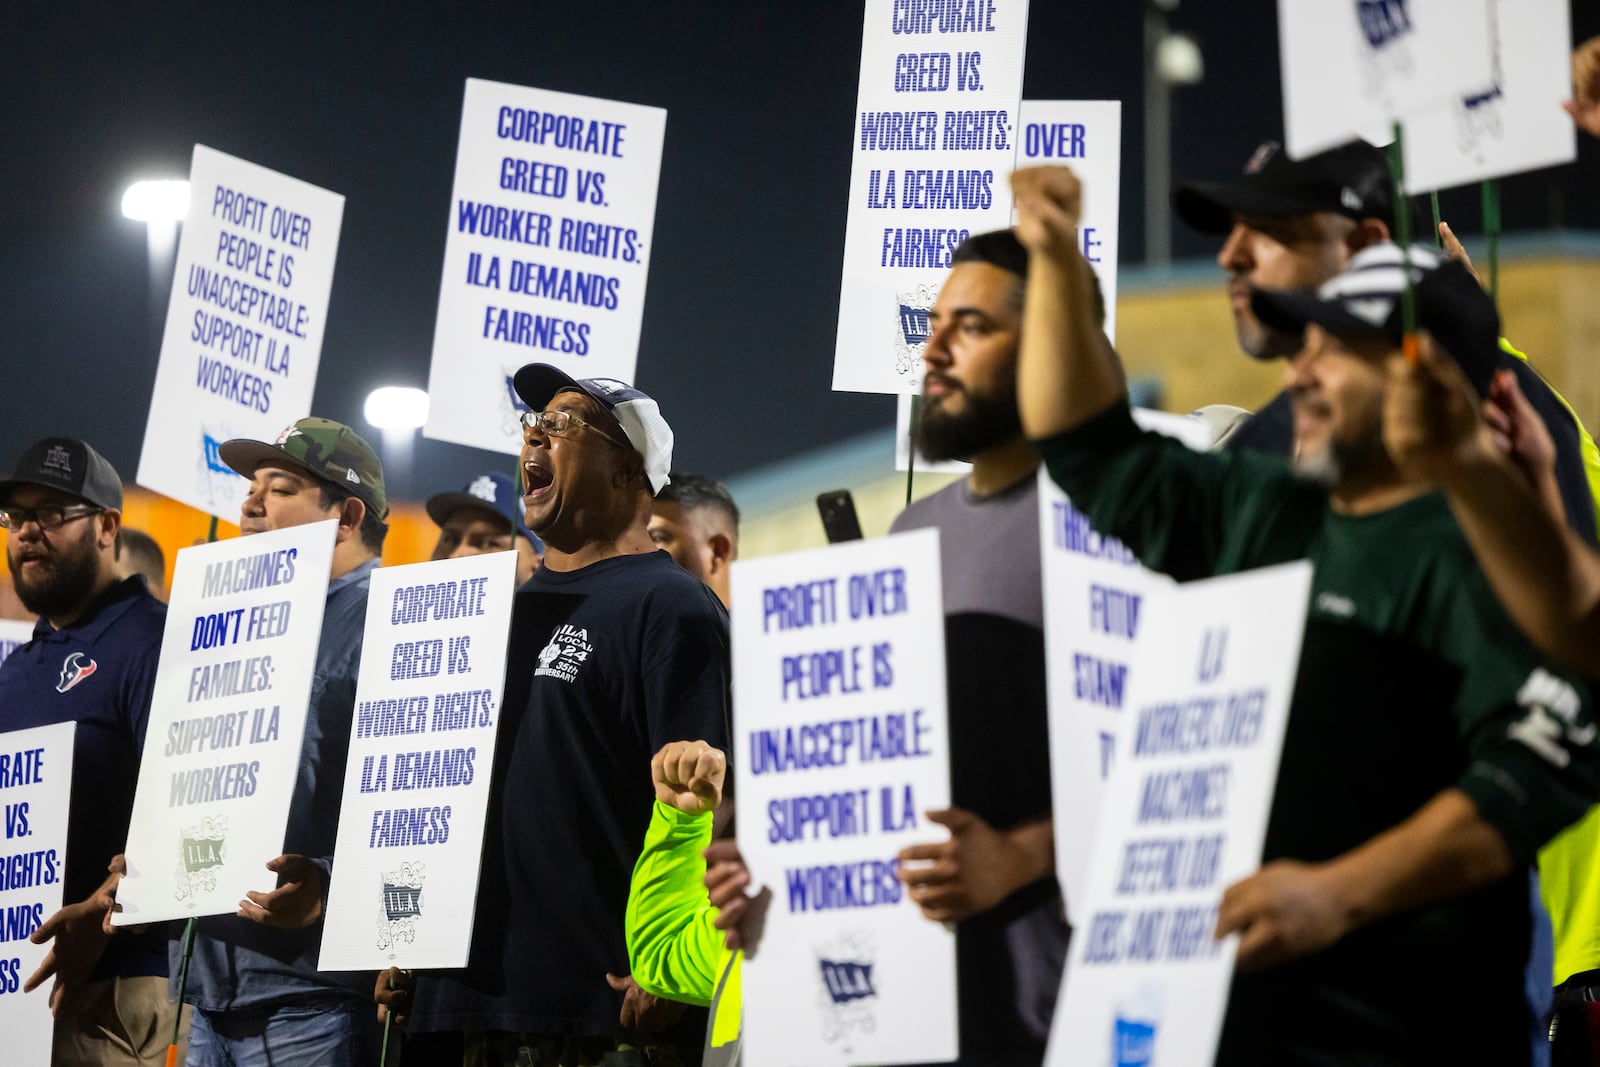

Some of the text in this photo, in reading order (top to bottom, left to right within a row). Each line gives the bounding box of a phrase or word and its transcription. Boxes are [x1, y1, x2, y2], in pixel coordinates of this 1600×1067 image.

[892, 0, 996, 35] CORPORATE
[895, 51, 984, 92] GREED VS.
[497, 106, 626, 158] CORPORATE
[861, 110, 1012, 151] WORKER RIGHTS:
[1025, 123, 1085, 158] OVER
[500, 157, 608, 207] GREED VS.
[868, 170, 993, 210] ILA DEMANDS
[213, 186, 311, 250] PROFIT OVER
[458, 200, 642, 264] WORKER RIGHTS:
[217, 231, 294, 288] PEOPLE IS
[466, 252, 620, 311] ILA DEMANDS
[188, 265, 309, 340] UNACCEPTABLE:
[192, 310, 289, 376] SUPPORT ILA
[483, 306, 590, 356] FAIRNESS
[197, 356, 272, 413] WORKERS
[202, 548, 298, 598] MACHINES
[392, 577, 488, 625] CORPORATE
[763, 568, 908, 632] PROFIT OVER
[190, 601, 291, 652] DON'T FEED
[558, 634, 593, 652] LOCAL
[560, 624, 588, 641] ILA
[391, 636, 472, 680] GREED VS.
[556, 661, 579, 675] 35th
[561, 645, 588, 661] 24
[782, 642, 893, 700] PEOPLE IS
[187, 656, 275, 702] FAMILIES:
[165, 706, 280, 756] SUPPORT ILA
[357, 689, 495, 741] WORKER RIGHTS:
[170, 761, 260, 806] WORKERS
[360, 747, 476, 793] ILA DEMANDS
[6, 802, 32, 839] VS.
[370, 806, 451, 848] FAIRNESS
[768, 784, 916, 844] SUPPORT ILA
[786, 857, 902, 913] WORKERS
